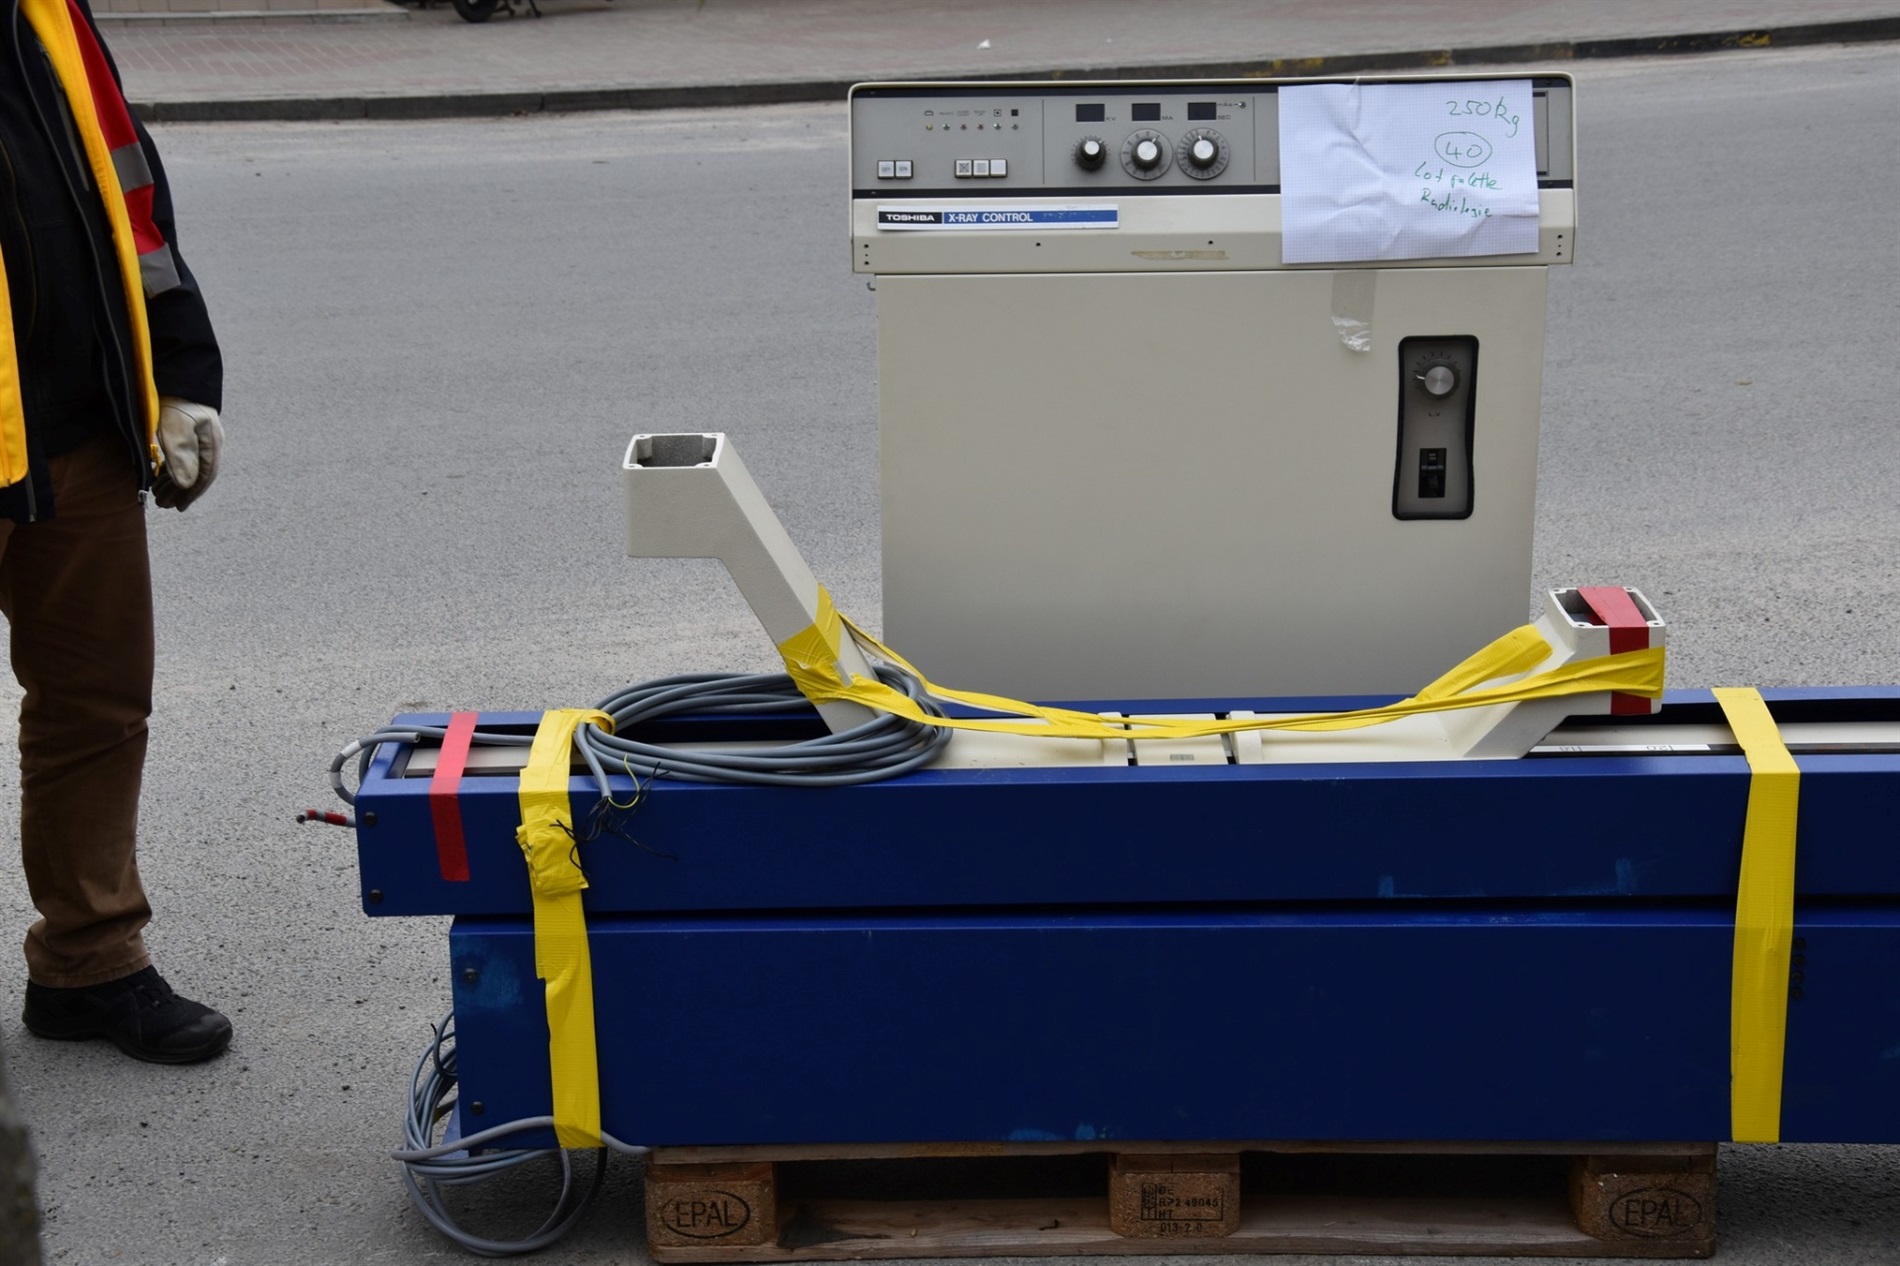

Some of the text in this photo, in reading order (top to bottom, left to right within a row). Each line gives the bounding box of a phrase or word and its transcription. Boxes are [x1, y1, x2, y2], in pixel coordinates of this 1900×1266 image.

[1446, 141, 1483, 160] 40
[885, 211, 1034, 223] TOSHIBA X-RAY CONTROL
[675, 1200, 739, 1228] EPAL
[1158, 1209, 1174, 1219] HT
[1625, 1198, 1691, 1227] EPAL
